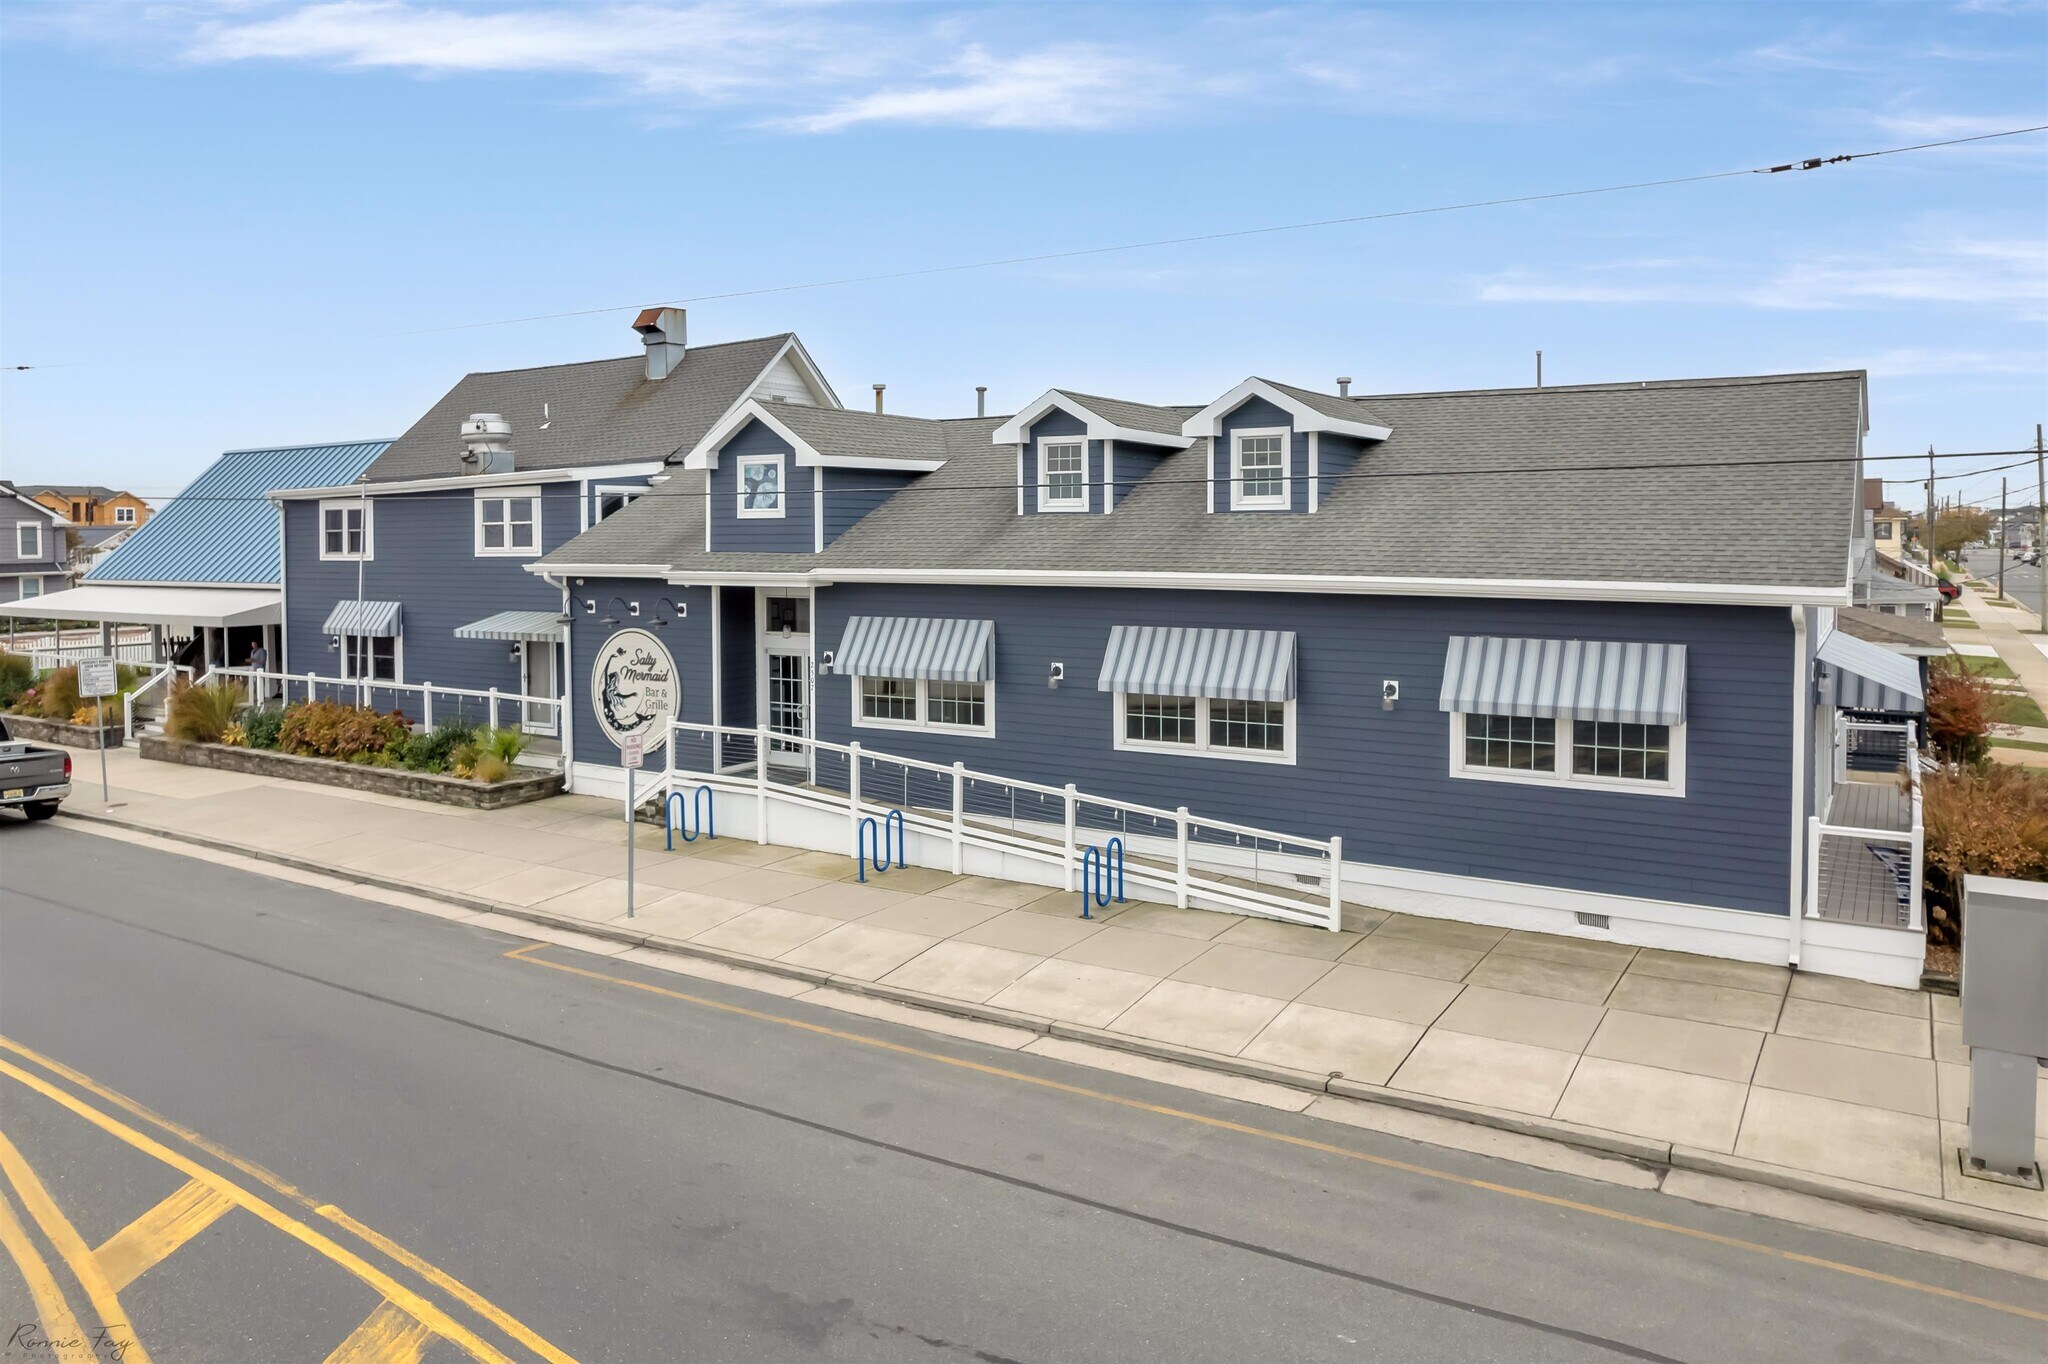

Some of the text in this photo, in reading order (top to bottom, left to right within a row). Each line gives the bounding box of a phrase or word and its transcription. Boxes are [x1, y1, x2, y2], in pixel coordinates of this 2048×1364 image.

[630, 648, 657, 672] Salty
[620, 665, 669, 684] Mermaid
[645, 686, 668, 698] Bar &
[644, 699, 668, 710] Grille
